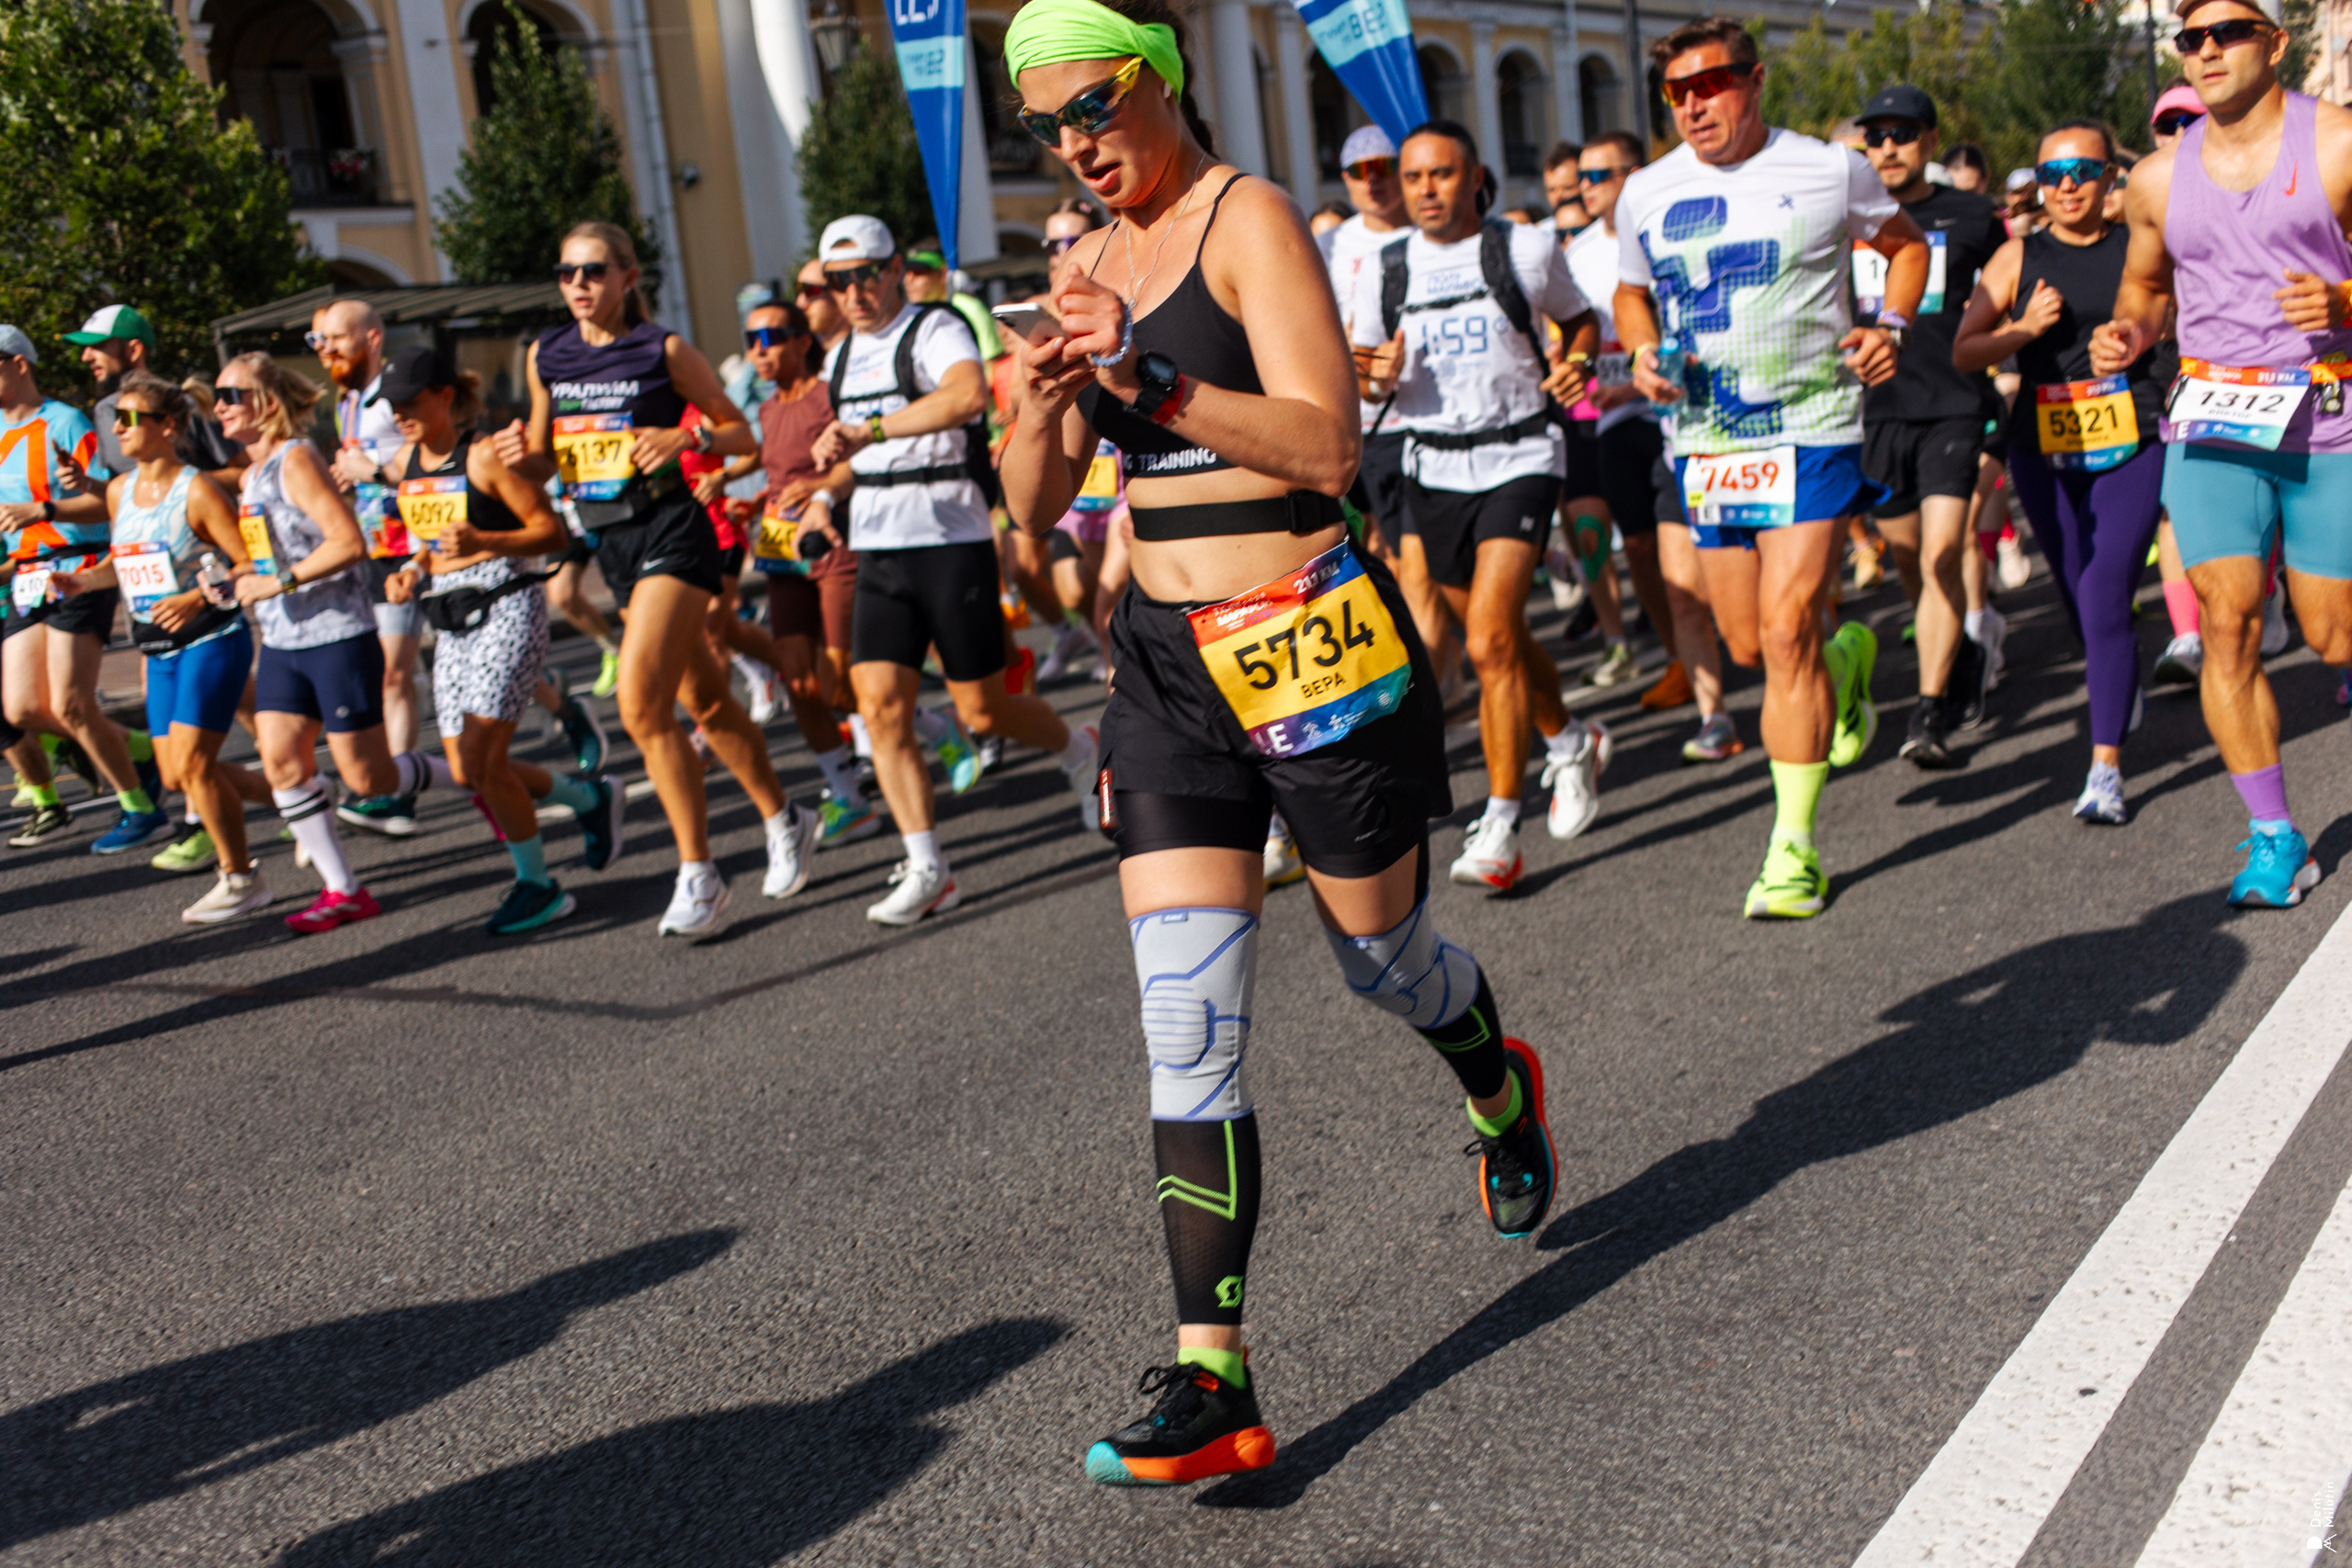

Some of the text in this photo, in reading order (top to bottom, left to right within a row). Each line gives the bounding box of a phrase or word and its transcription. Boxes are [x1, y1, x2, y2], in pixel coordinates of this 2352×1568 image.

[1422, 316, 1487, 355] 1:59
[2199, 389, 2285, 413] 1312
[2050, 403, 2118, 437] 5321
[567, 439, 622, 467] 6137
[1137, 446, 1217, 471] TRAINING
[1701, 461, 1779, 492] 7459
[411, 501, 456, 525] 6092
[118, 563, 164, 587] 7015
[1234, 599, 1375, 690] 5734
[1301, 671, 1346, 699] ВЕРА
